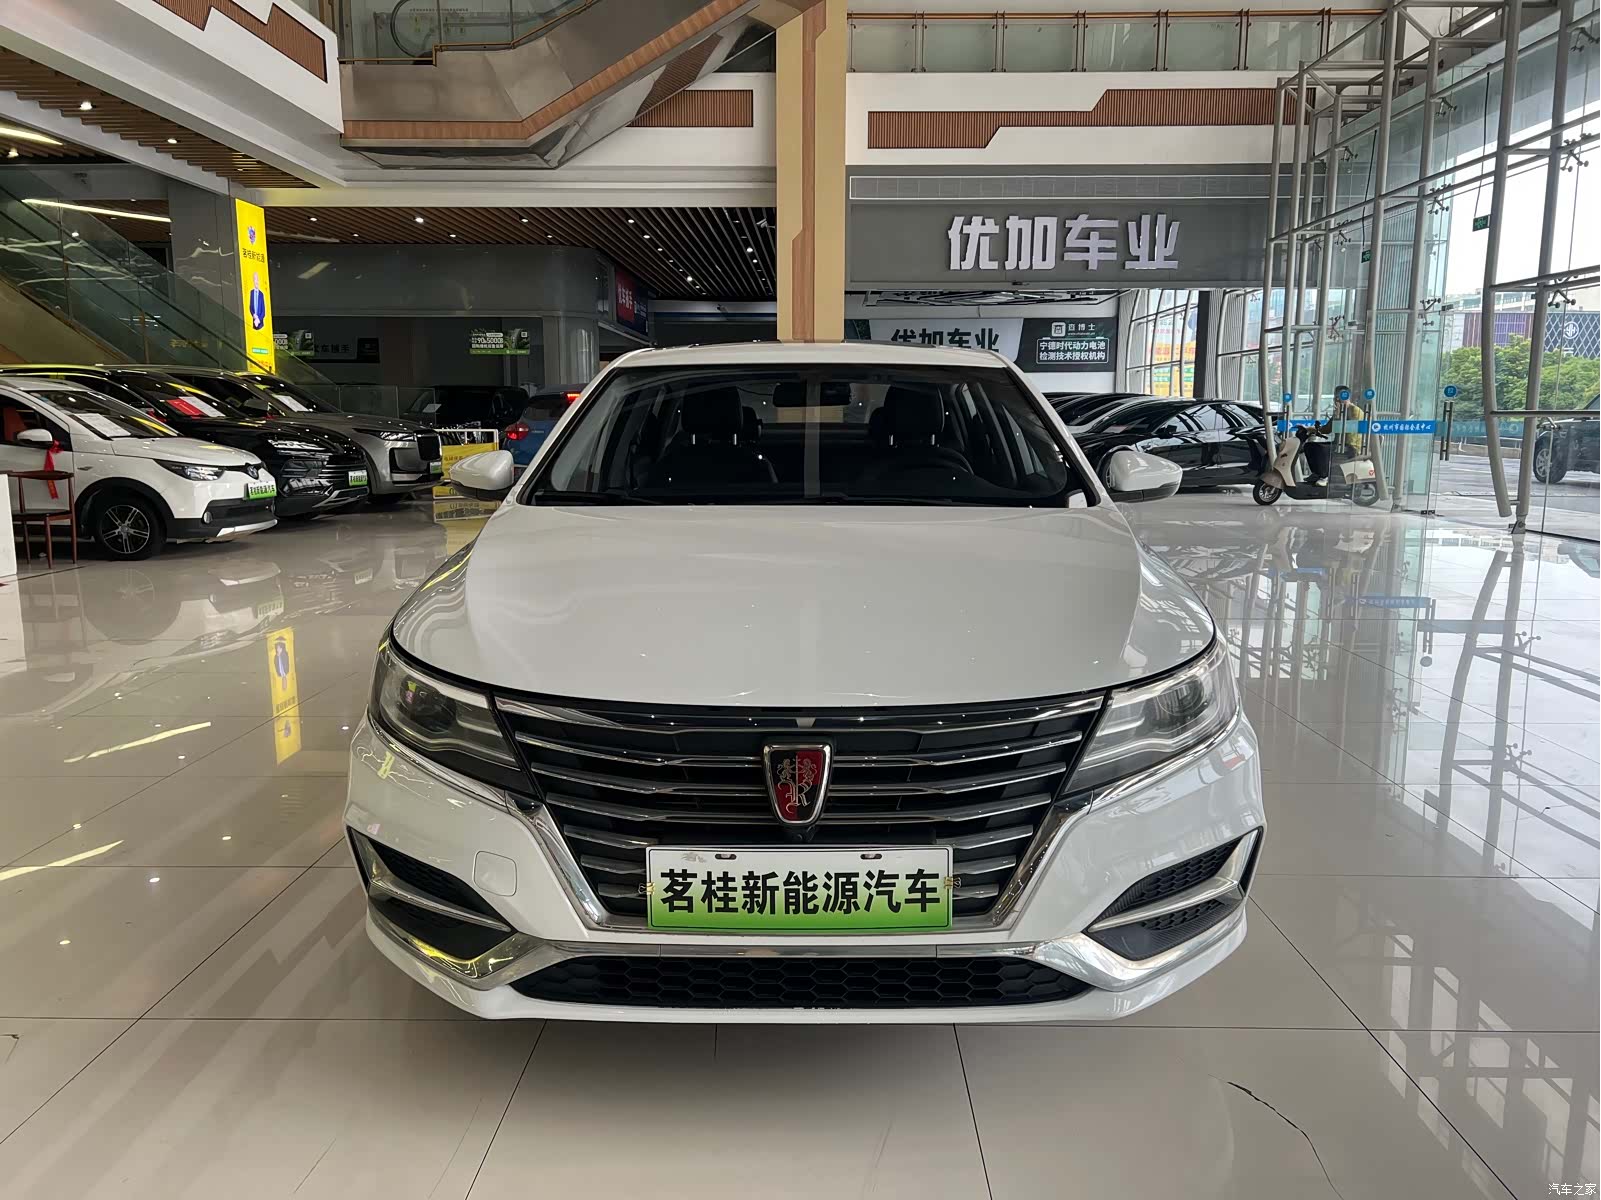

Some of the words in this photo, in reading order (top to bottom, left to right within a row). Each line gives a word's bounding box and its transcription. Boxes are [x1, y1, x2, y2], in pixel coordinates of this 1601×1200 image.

[949, 214, 1181, 271] 优加车业
[1039, 341, 1106, 350] 宁德时代动力电池
[1039, 352, 1106, 361] 检测技术授权机构
[660, 868, 941, 915] 茗桂新能源汽车
